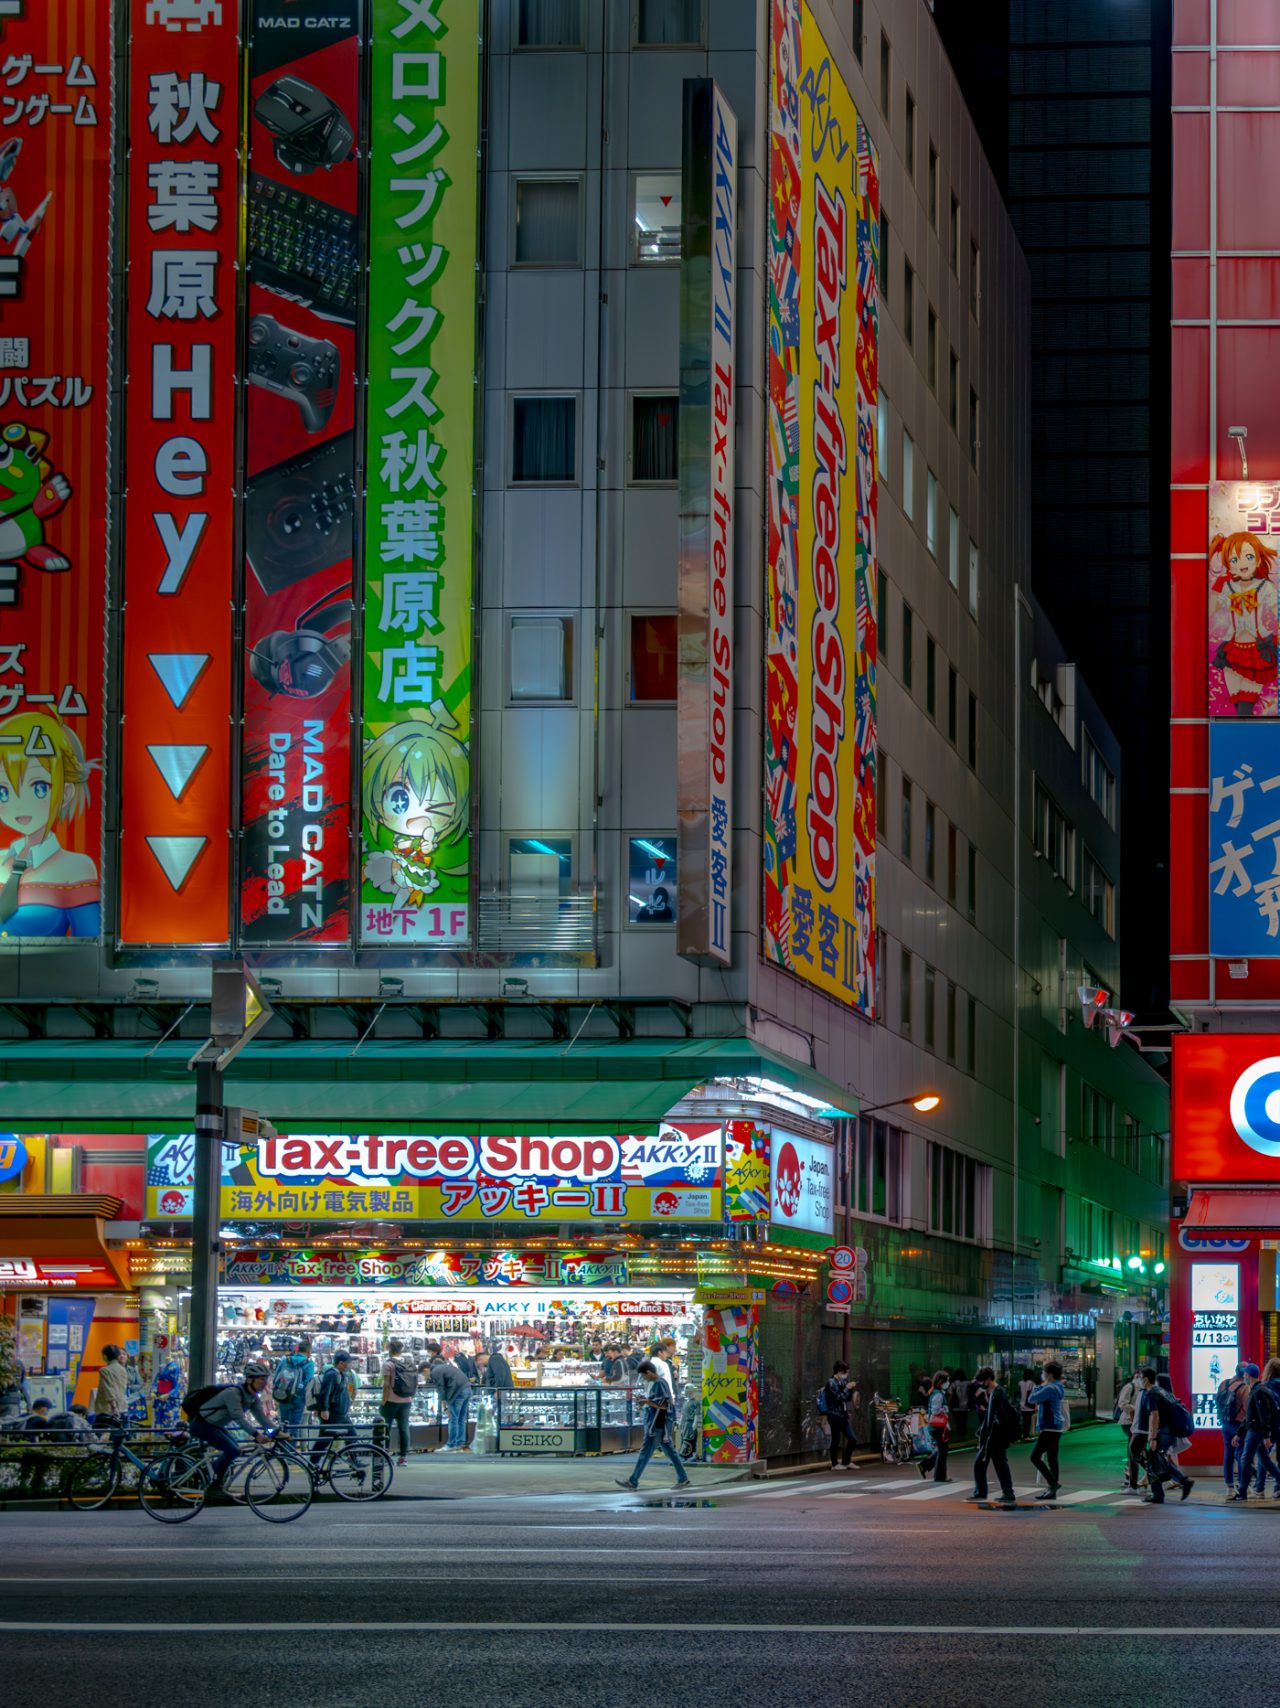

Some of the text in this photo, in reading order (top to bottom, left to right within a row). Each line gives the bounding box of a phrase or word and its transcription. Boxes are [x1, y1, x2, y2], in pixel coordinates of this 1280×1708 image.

[258, 17, 351, 28] MAD CATZ
[715, 99, 733, 305] AKKY
[713, 362, 732, 615] Tax-free
[807, 173, 847, 890] Tax-free Shop
[710, 626, 731, 785] Shop
[267, 733, 292, 915] Dare to Lead
[301, 720, 324, 928] MAD CATZ
[264, 1135, 620, 1176] Tax-free Shop
[628, 1144, 699, 1164] AKKY
[806, 1177, 830, 1200] Tax-free
[231, 1190, 414, 1213] 海外向け電気製品
[814, 1200, 830, 1222] Shop
[230, 1262, 267, 1274] AKKY
[287, 1261, 357, 1277] Tax-free
[361, 1260, 402, 1278] Shop
[836, 1253, 851, 1265] 20
[484, 1302, 530, 1312] AKKY
[620, 1303, 663, 1313] Clearance
[1194, 1314, 1237, 1325] ちいかわ
[511, 1434, 563, 1447] SEIKO
